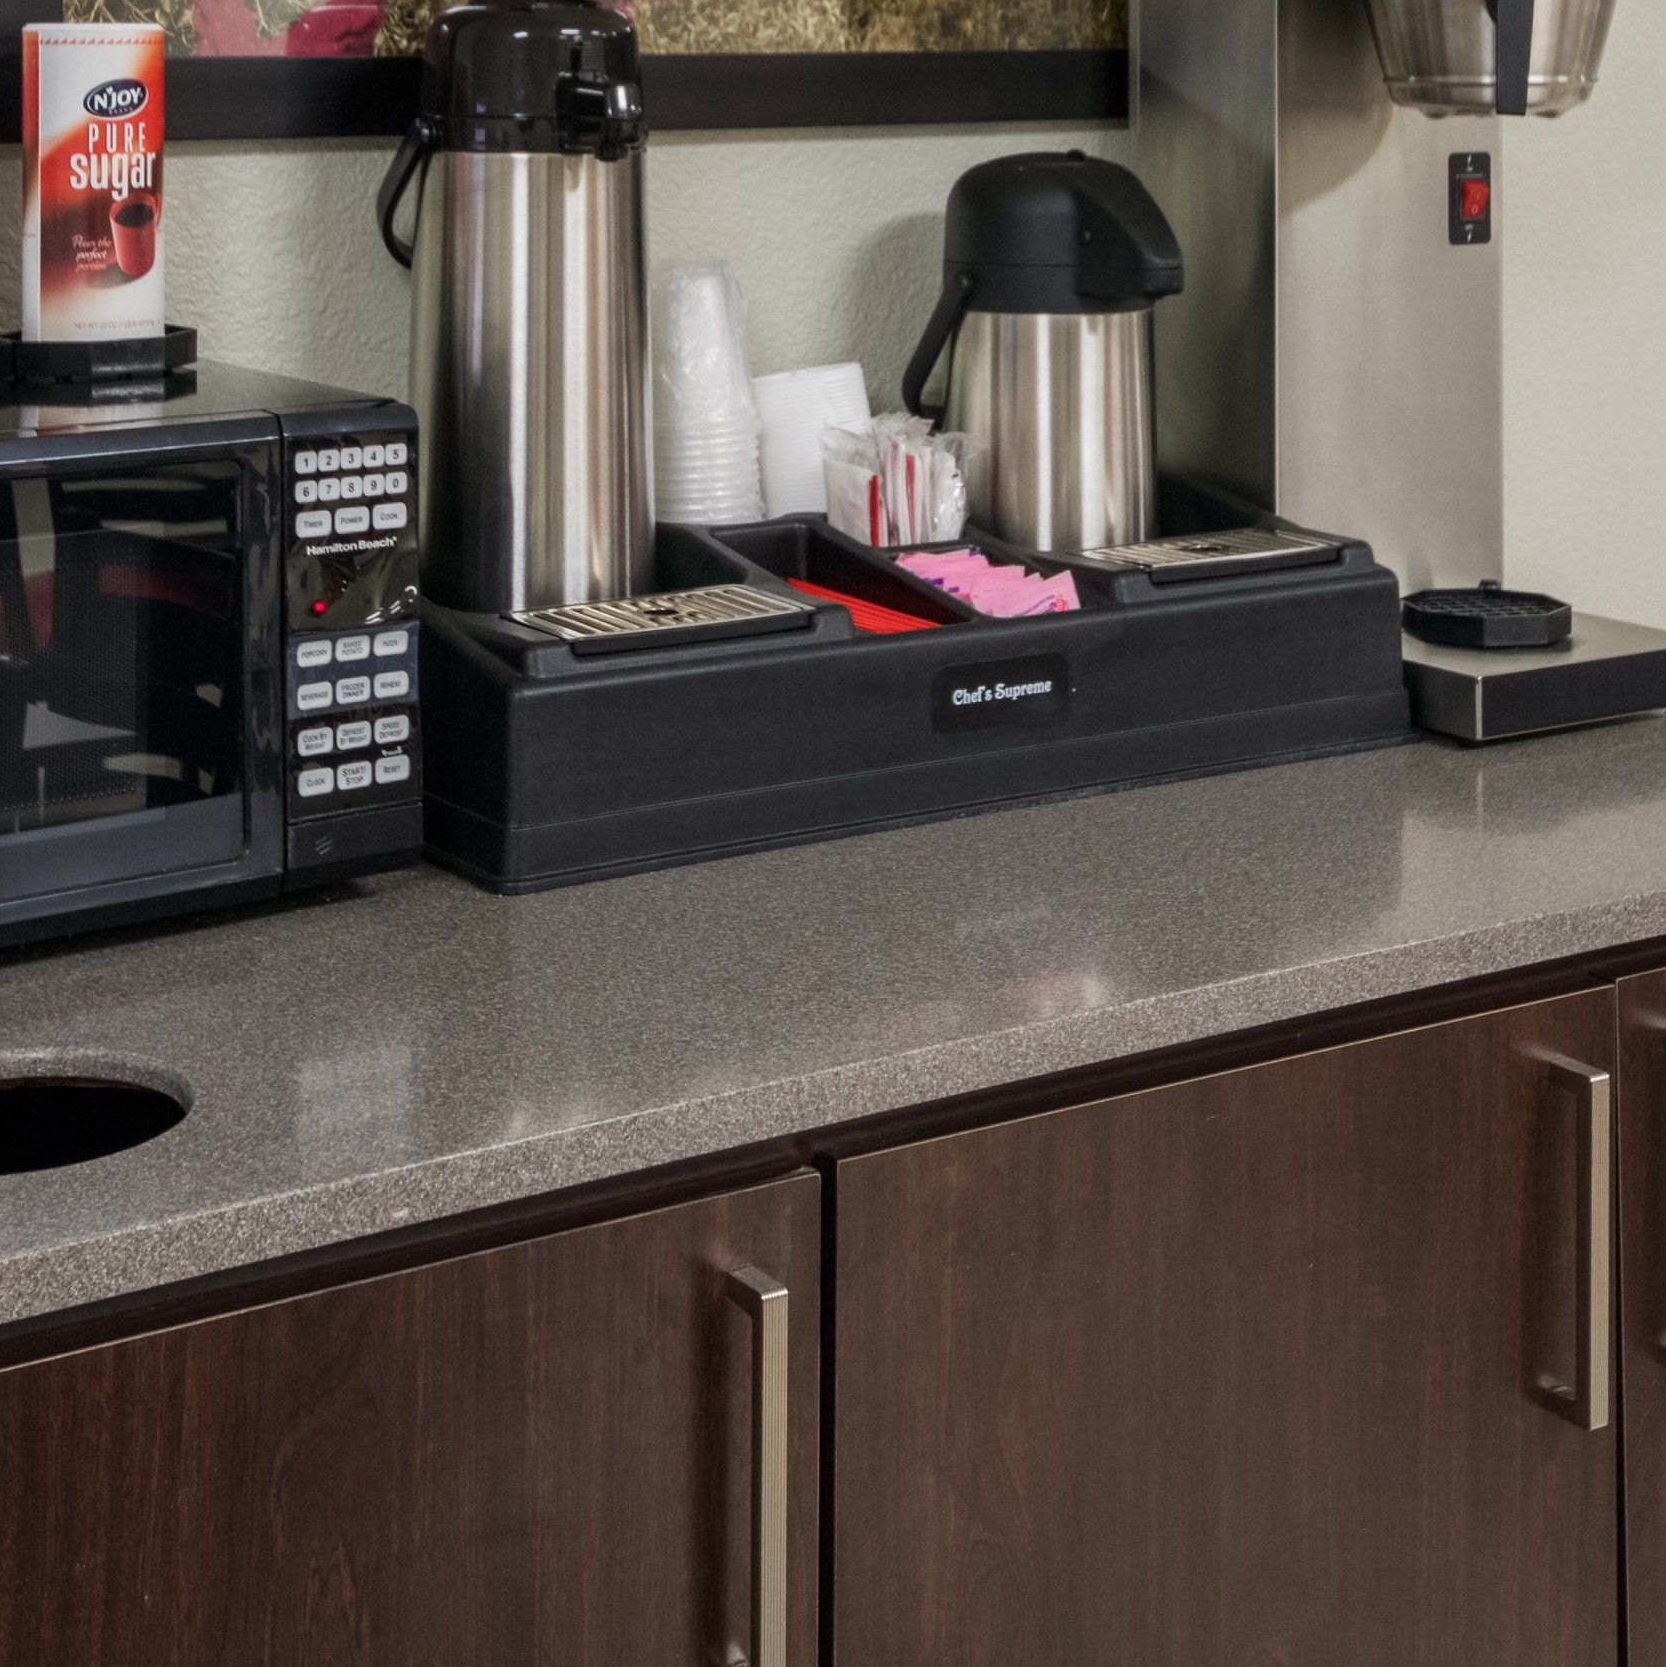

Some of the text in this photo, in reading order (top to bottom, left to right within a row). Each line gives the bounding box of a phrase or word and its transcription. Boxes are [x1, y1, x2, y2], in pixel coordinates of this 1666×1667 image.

[88, 122, 146, 153] PURE
[70, 151, 156, 202] sugar
[303, 449, 399, 468] 1 2 3 4 5
[302, 478, 399, 497] 6 7 8 9 0
[306, 541, 358, 556] Hamilton
[952, 680, 1053, 705] Chef's Supreme
[345, 775, 364, 785] STOP
